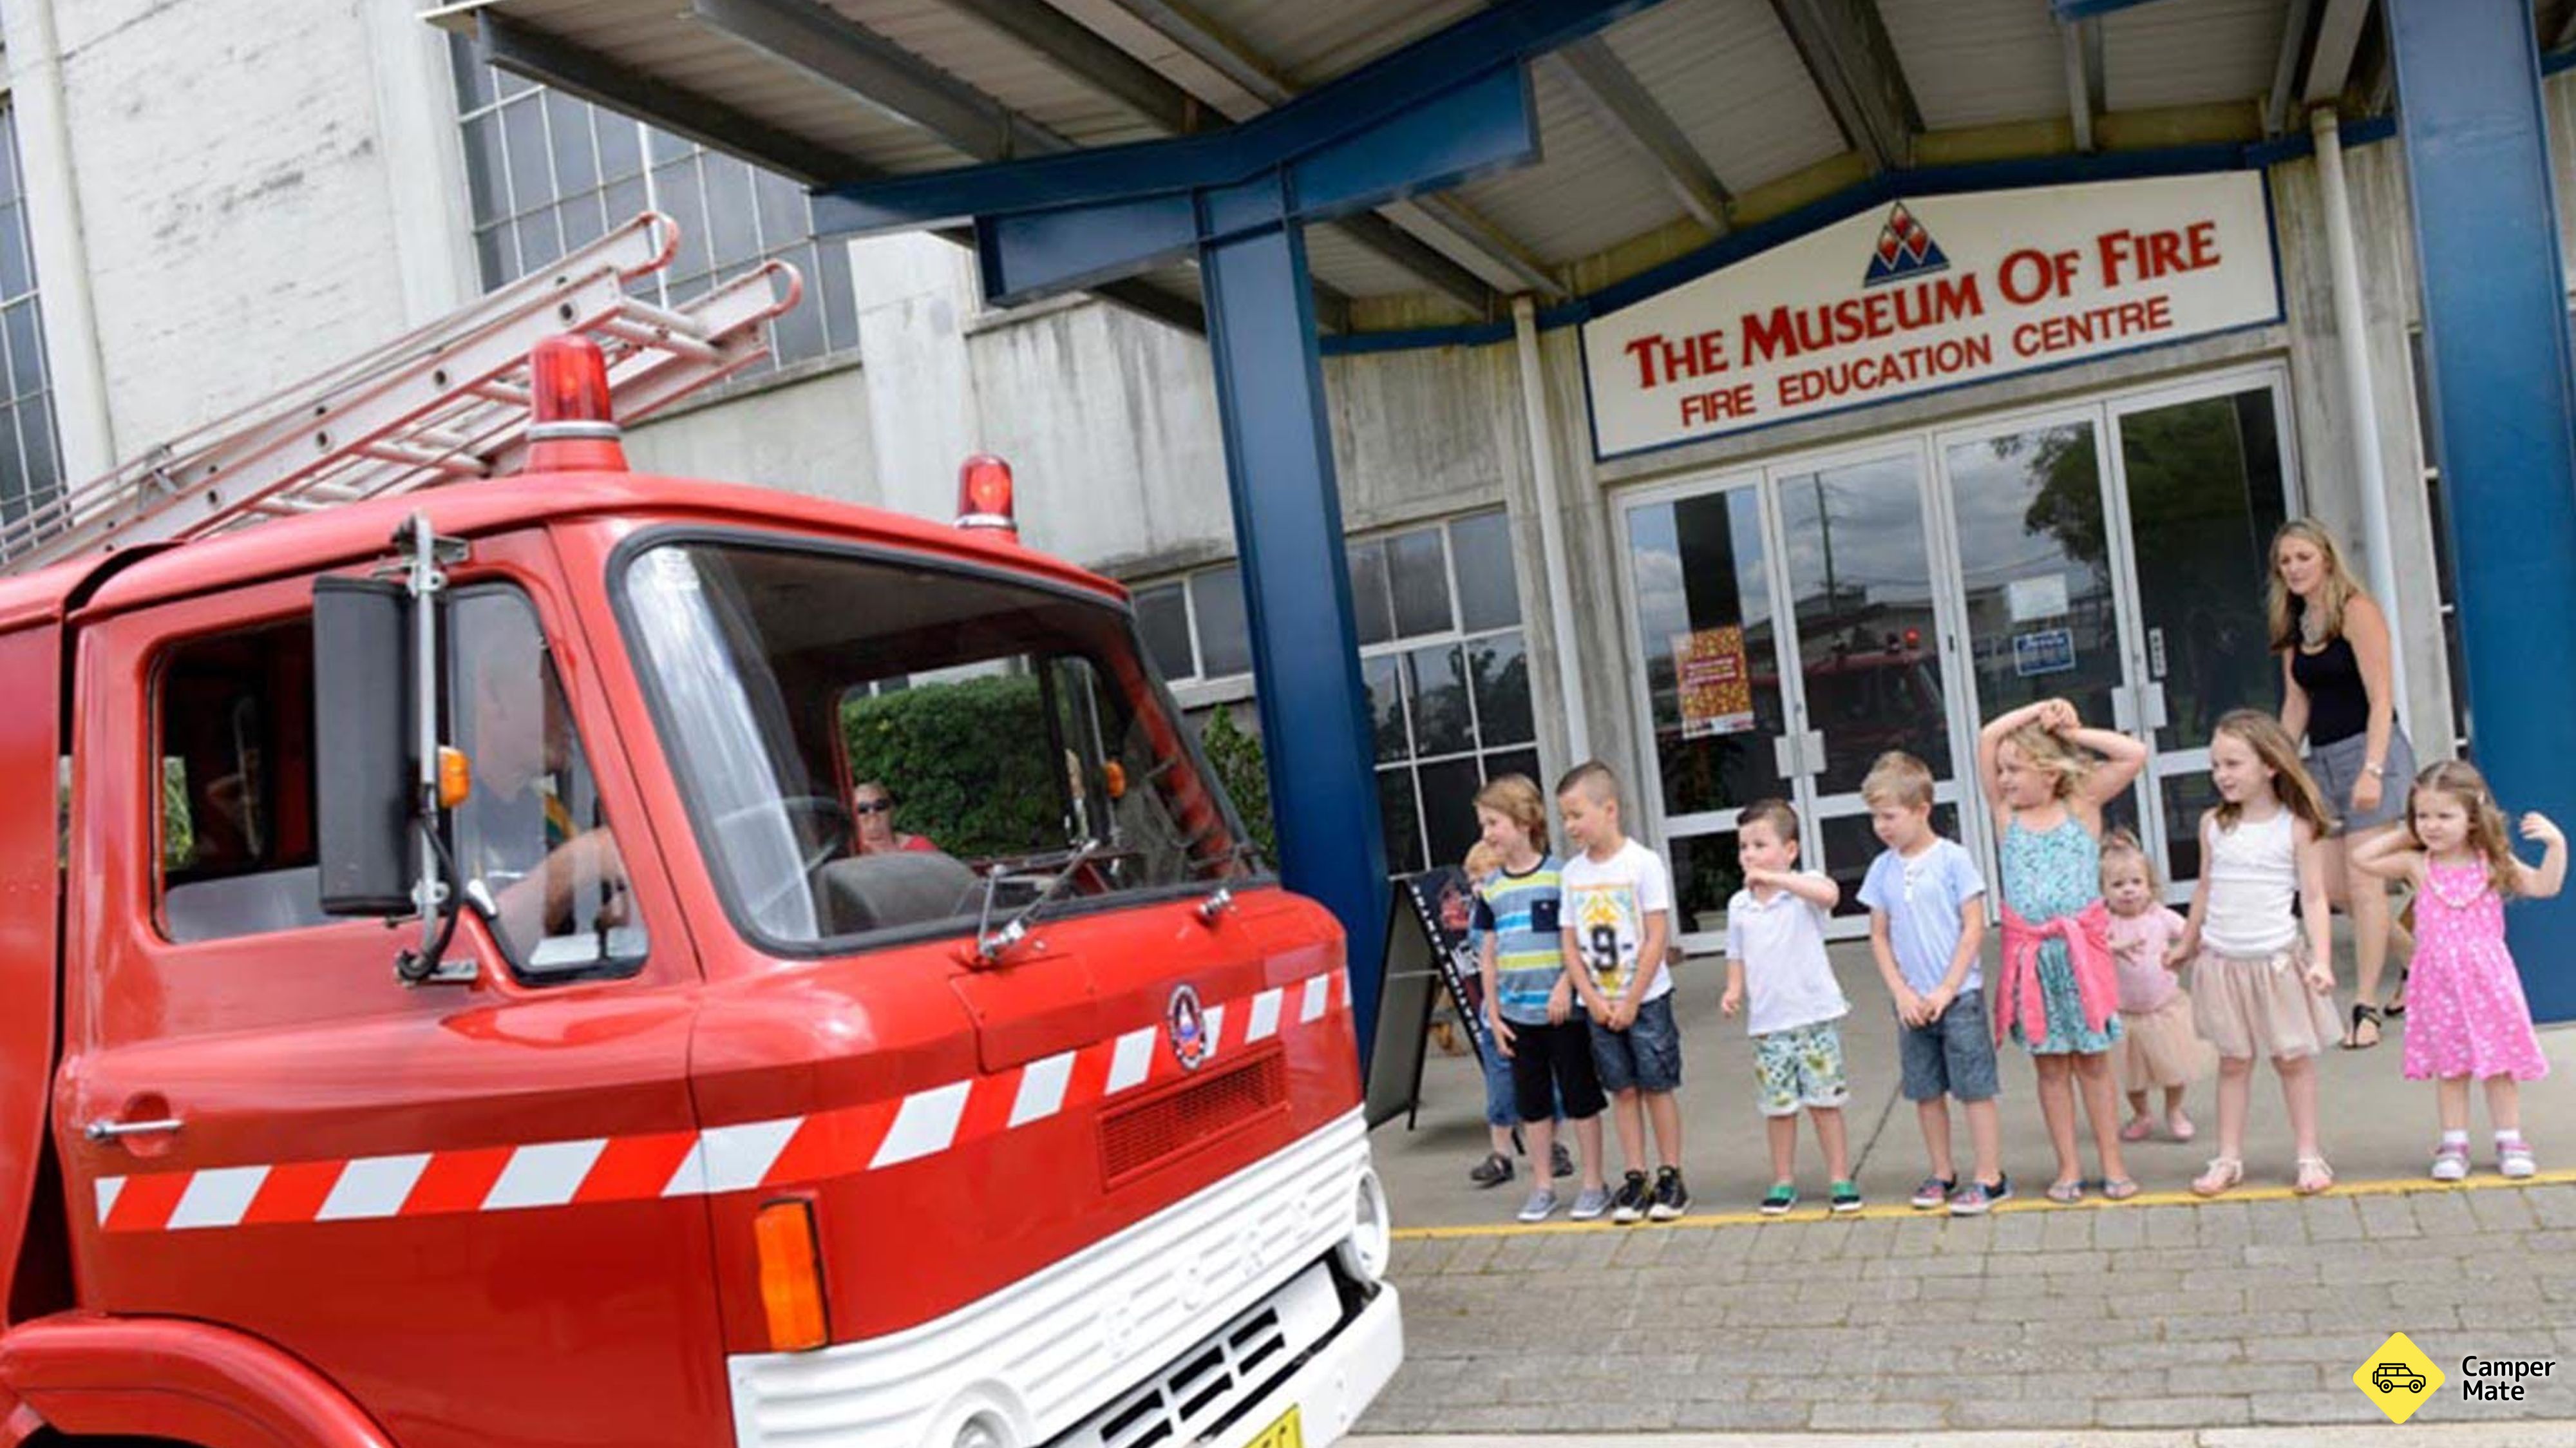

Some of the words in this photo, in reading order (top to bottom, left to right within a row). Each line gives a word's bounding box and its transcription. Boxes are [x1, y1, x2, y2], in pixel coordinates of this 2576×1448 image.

[1625, 331, 1728, 389] THE
[1741, 273, 1984, 369] MUSEUM
[1998, 249, 2081, 306] OF
[2098, 221, 2221, 288] FIRE
[1680, 385, 1756, 427] FIRE
[1779, 334, 1993, 407] EDUCATION
[2012, 296, 2173, 357] CENTRE
